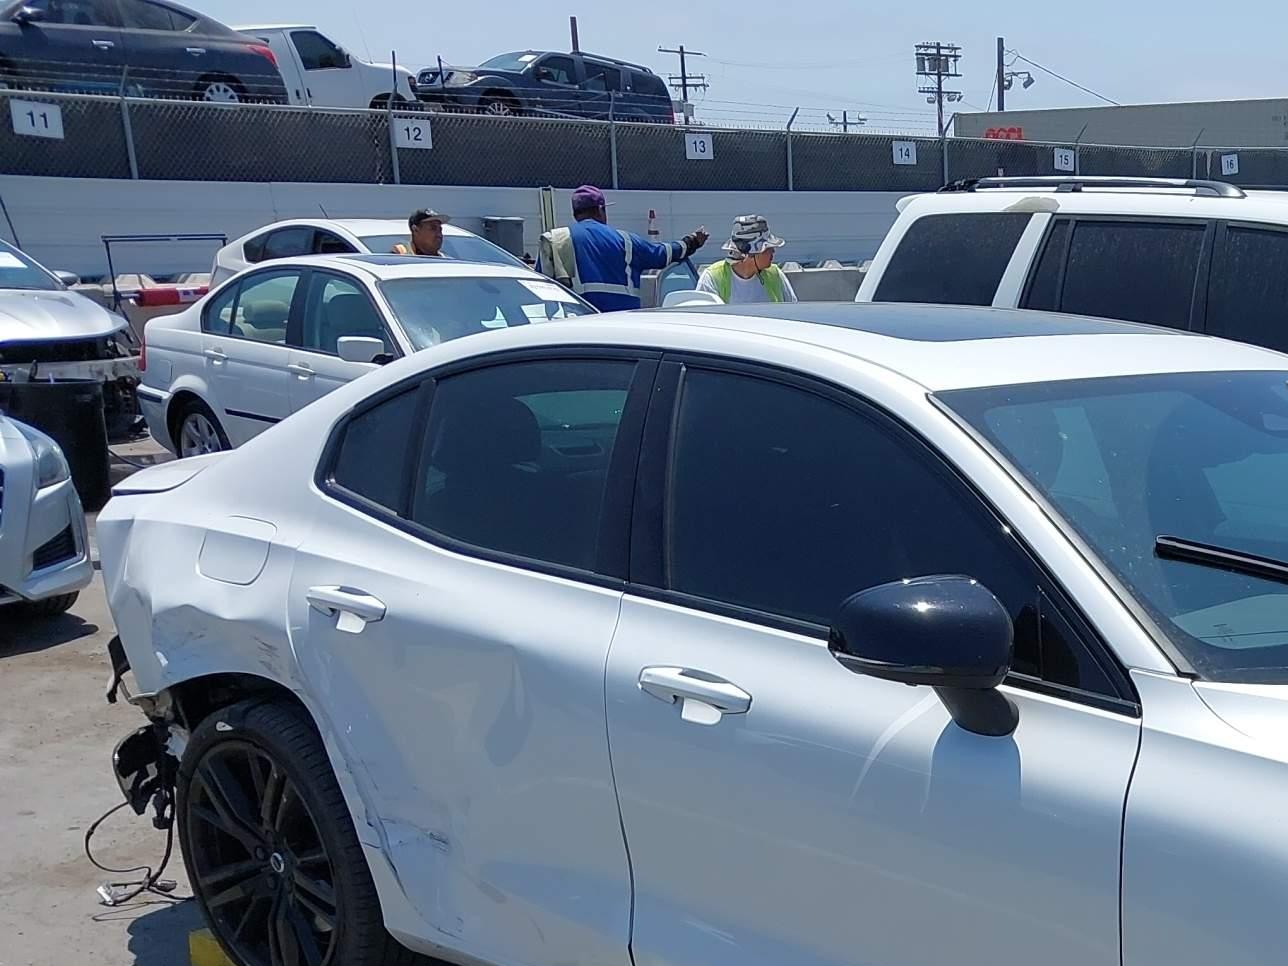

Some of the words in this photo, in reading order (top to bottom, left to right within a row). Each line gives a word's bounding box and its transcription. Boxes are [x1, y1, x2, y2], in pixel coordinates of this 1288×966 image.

[26, 110, 48, 129] 11
[404, 126, 422, 141] 12
[692, 140, 706, 153] 13
[899, 147, 910, 159] 14
[1060, 154, 1069, 166] 15
[1226, 159, 1234, 170] 16
